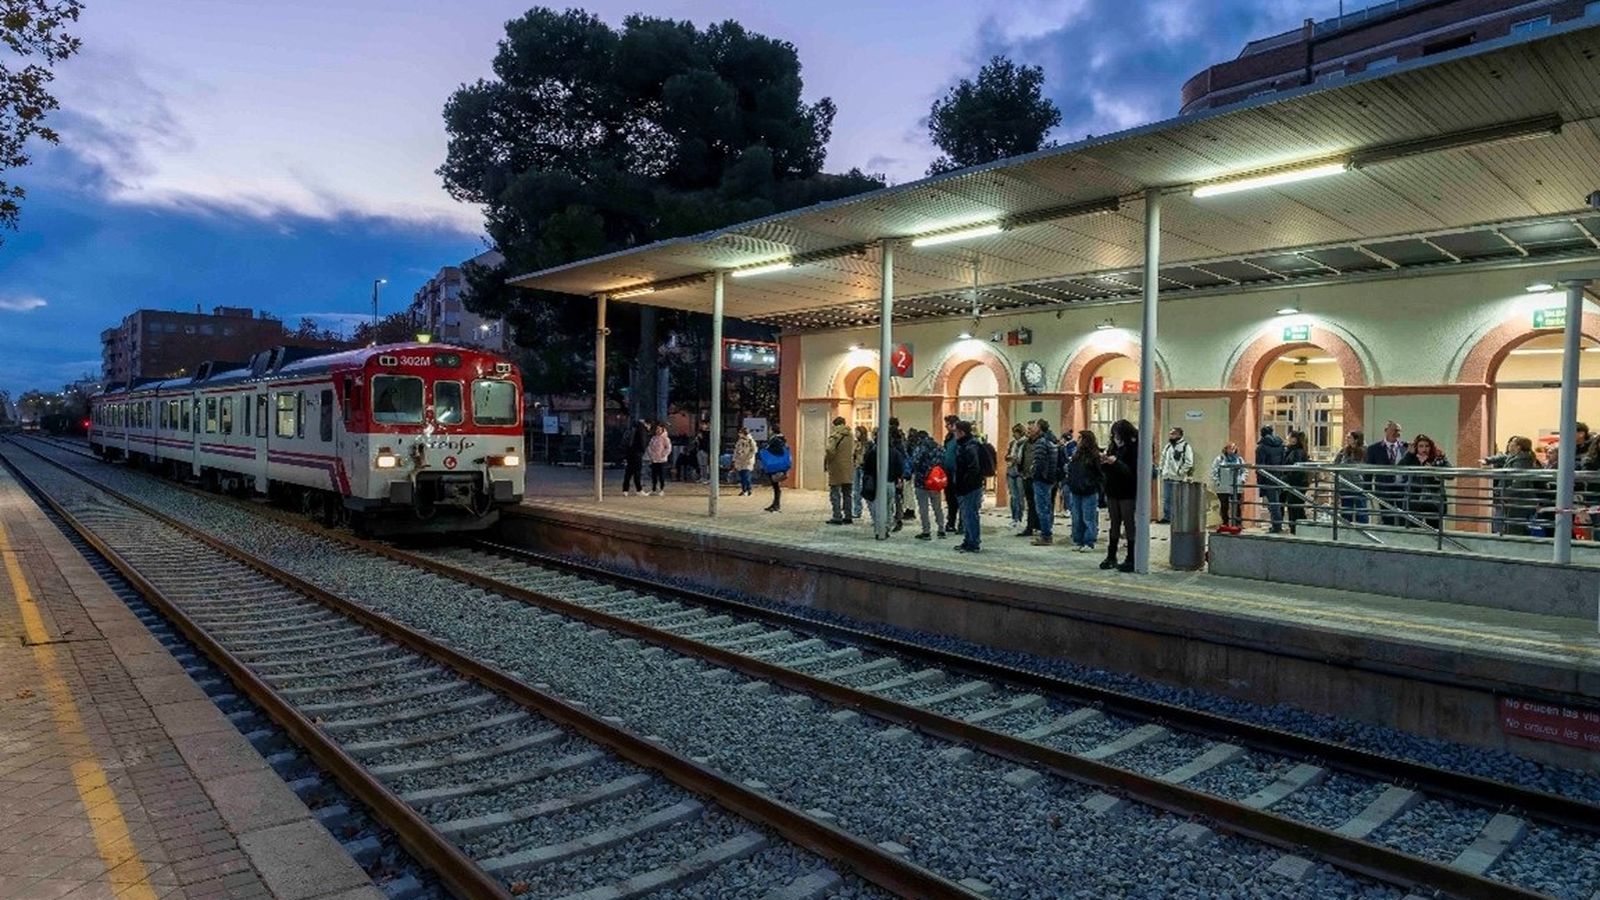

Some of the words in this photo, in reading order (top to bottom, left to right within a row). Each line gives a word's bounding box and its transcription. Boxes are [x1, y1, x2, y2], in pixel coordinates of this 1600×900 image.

[400, 355, 431, 367] 302M
[897, 350, 906, 369] 2
[1505, 698, 1520, 709] No
[1505, 718, 1520, 729] No
